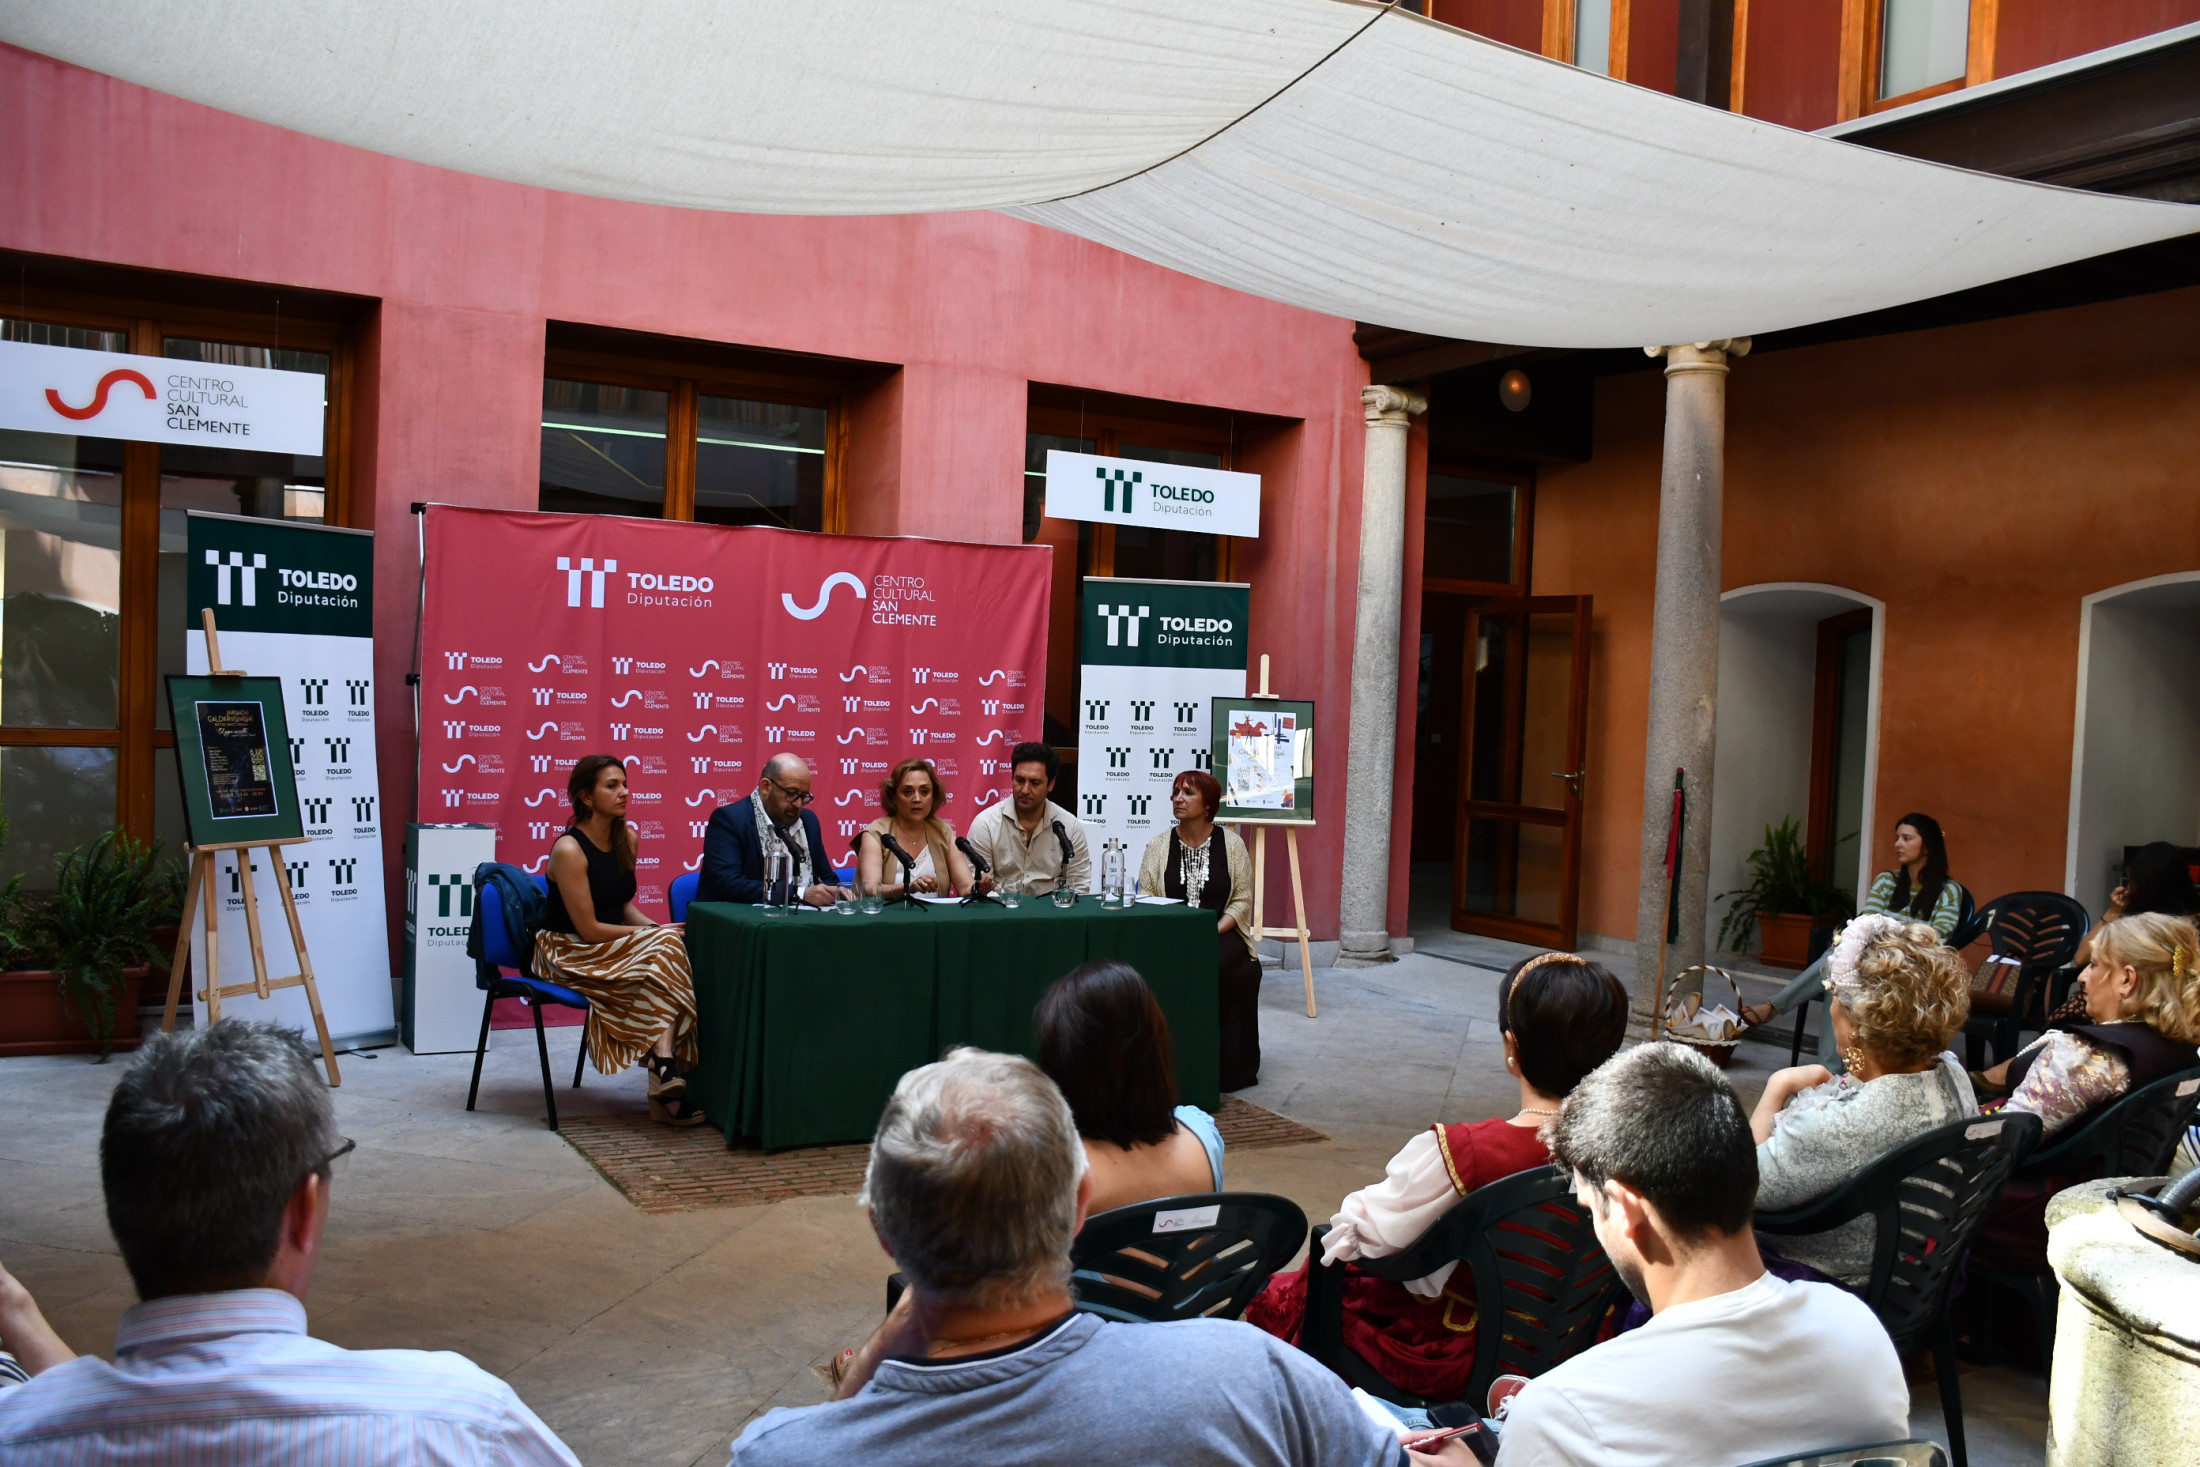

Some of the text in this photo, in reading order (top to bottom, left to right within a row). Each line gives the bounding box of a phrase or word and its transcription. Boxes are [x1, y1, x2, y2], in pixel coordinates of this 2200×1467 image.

[168, 375, 234, 392] CENTRO
[167, 389, 248, 408] CULTURAL
[167, 403, 199, 417] SAN
[167, 417, 250, 435] CLEMENTE
[1150, 484, 1214, 503] TOLEDO
[1153, 501, 1212, 516] Diputación
[279, 568, 357, 591] TOLEDO
[627, 572, 714, 593] TOLEDO
[874, 575, 925, 588] CENTRO
[278, 591, 358, 608] Diputación
[627, 593, 712, 608] Diputación
[874, 588, 935, 602] CULTURAL
[873, 600, 898, 612] SAN
[872, 613, 936, 626] CLEMENTE
[1160, 617, 1232, 633] TOLEDO
[1158, 634, 1233, 646] Diputación
[428, 927, 471, 937] TOLED
[427, 939, 466, 947] Diputac
